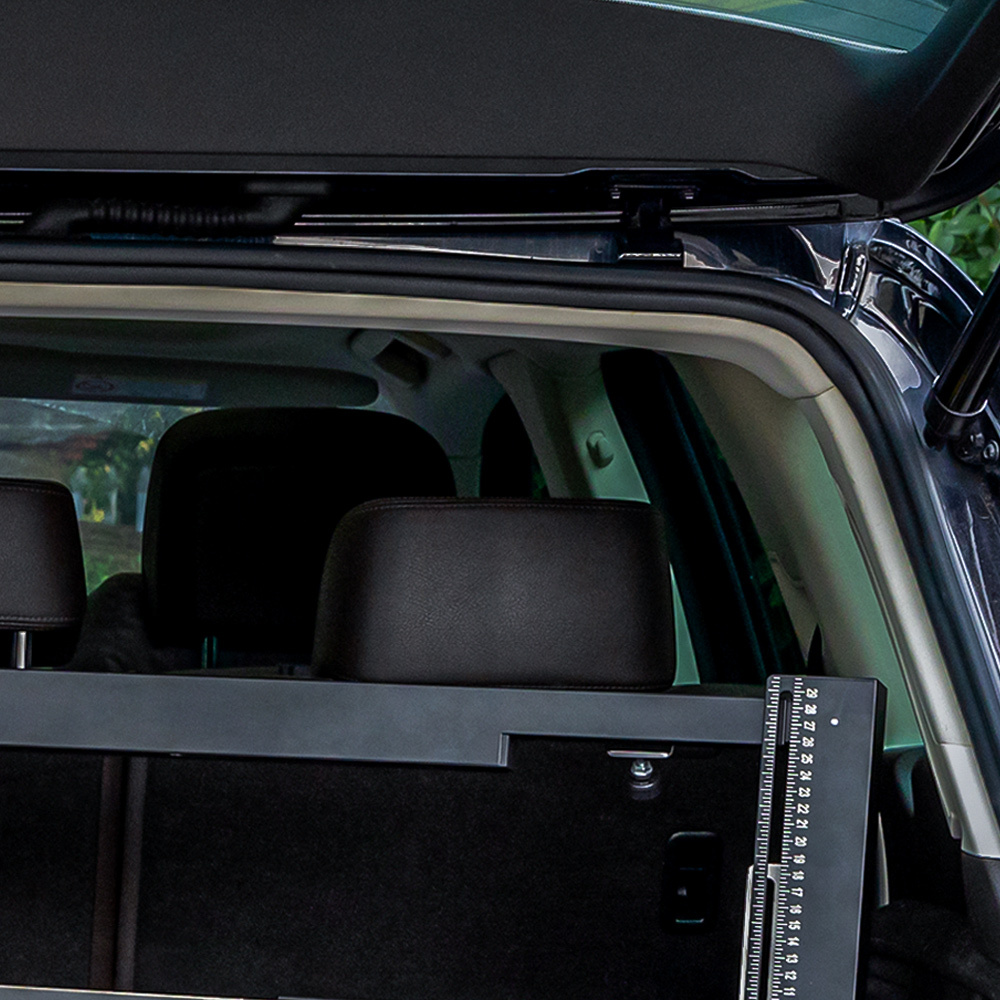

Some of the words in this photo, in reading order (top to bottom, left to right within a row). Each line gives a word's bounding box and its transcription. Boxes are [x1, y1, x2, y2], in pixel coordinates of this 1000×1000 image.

[807, 688, 818, 699] 29
[805, 705, 817, 714] 28
[804, 721, 816, 731] 27
[803, 737, 814, 747] 26
[801, 754, 813, 764] 25
[800, 771, 811, 781] 24
[798, 787, 810, 797] 23
[797, 804, 809, 814] 22
[796, 820, 808, 829] 21
[794, 836, 807, 847] 20
[793, 855, 805, 864] 19
[792, 870, 804, 881] 18
[790, 887, 803, 897] 17
[789, 904, 801, 914] 16
[788, 920, 800, 930] 15
[788, 937, 800, 946] 14
[786, 954, 798, 963] 13
[785, 971, 797, 980] 12
[784, 987, 796, 996] 11
